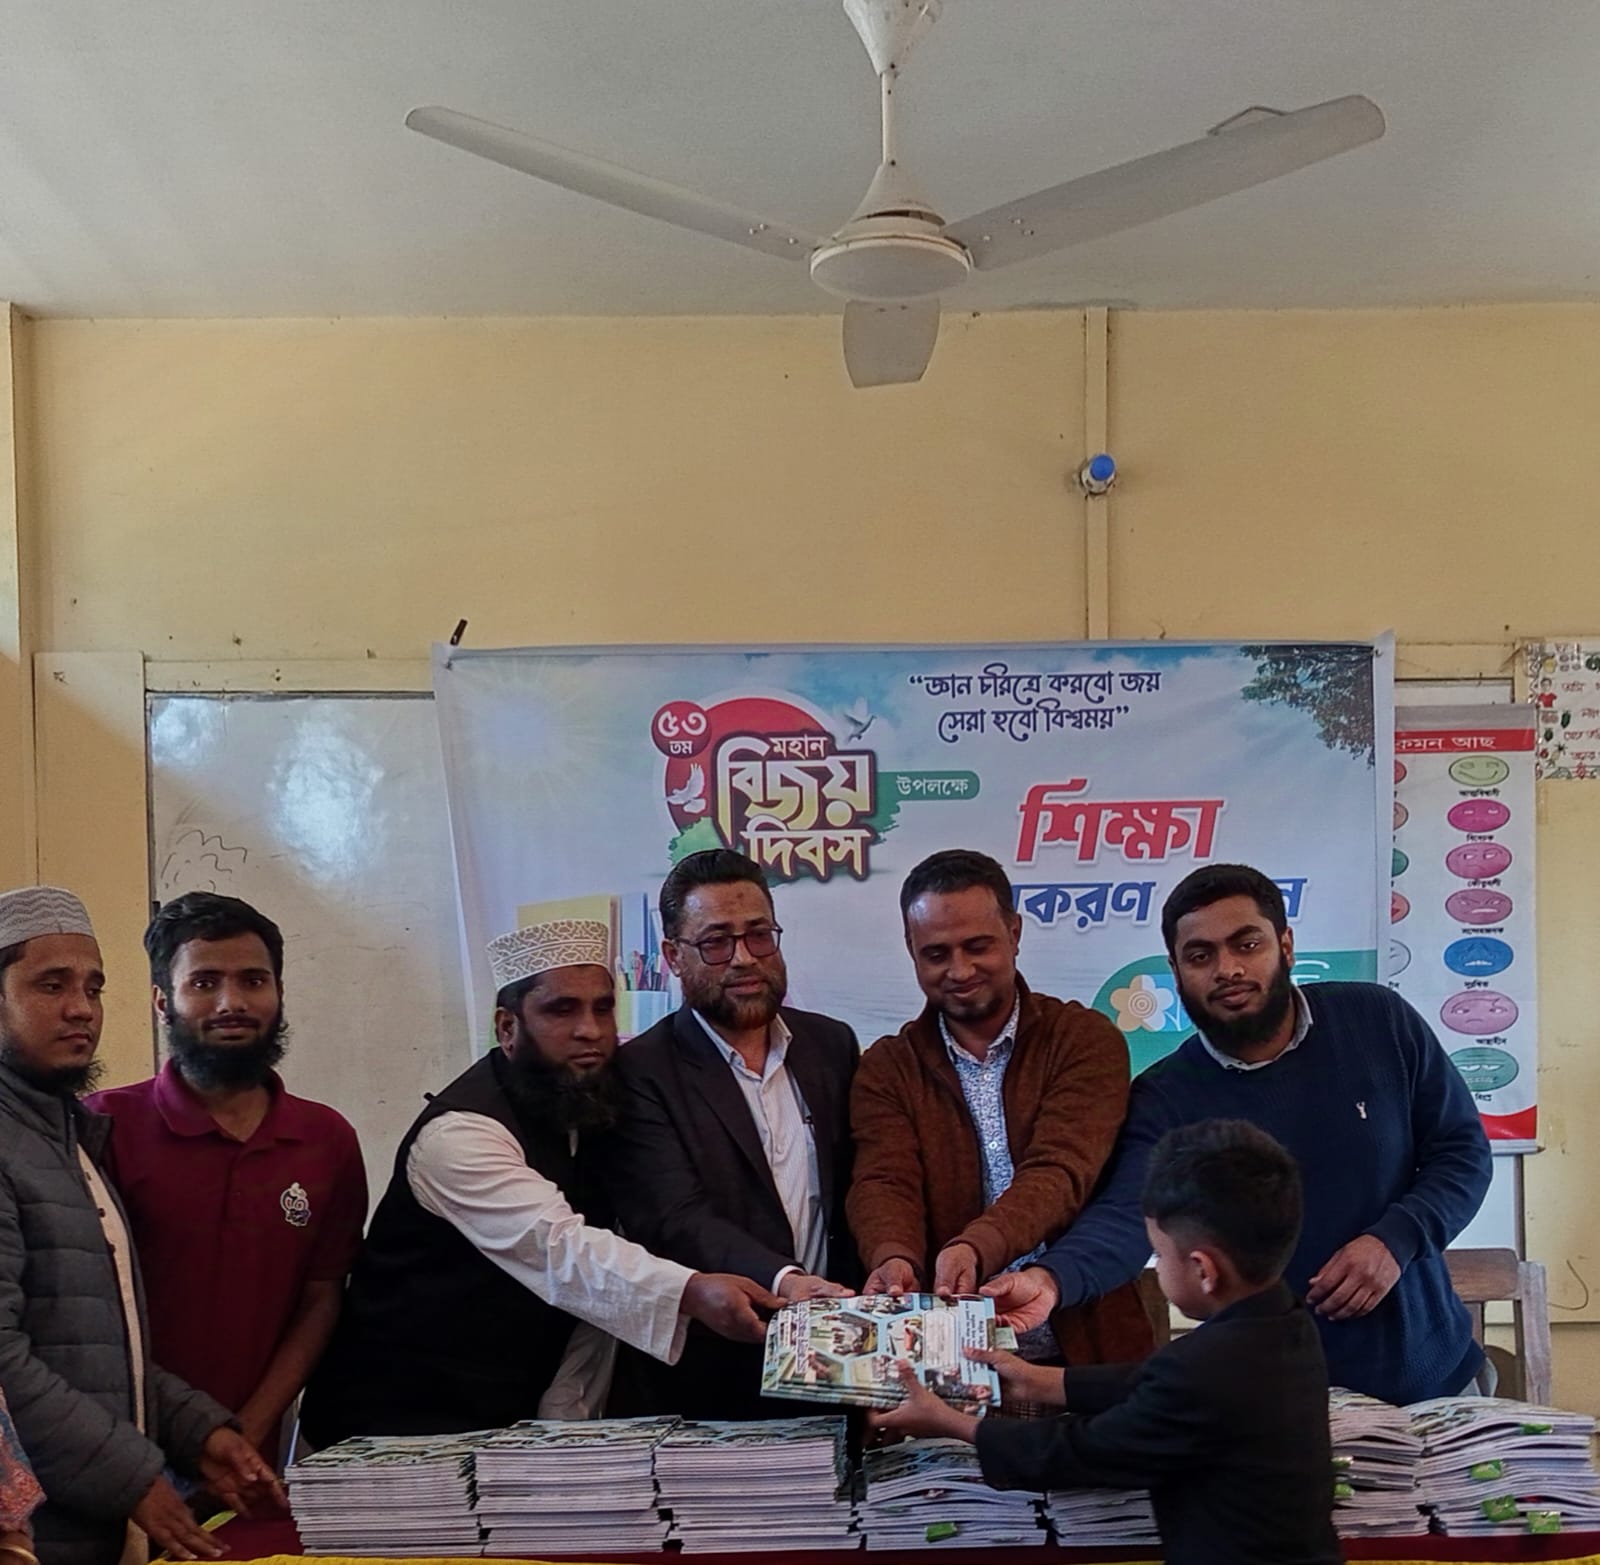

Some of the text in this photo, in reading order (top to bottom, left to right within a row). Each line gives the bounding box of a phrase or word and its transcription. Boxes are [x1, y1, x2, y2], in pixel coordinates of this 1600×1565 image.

[909, 662, 1161, 704] “জ্ঞান চরিত্রে করবো জয়
[657, 710, 708, 737] ৫৩
[938, 697, 1129, 743] সেরা হবো বিশ্বময়”
[669, 741, 694, 755] তম
[769, 735, 829, 759] মহান
[716, 735, 872, 848] বিজয়
[896, 776, 970, 797] উপলক্ষে
[1016, 778, 1225, 862] শিক্ষা
[740, 813, 873, 878] দিবস
[1012, 881, 1157, 930] করণ
